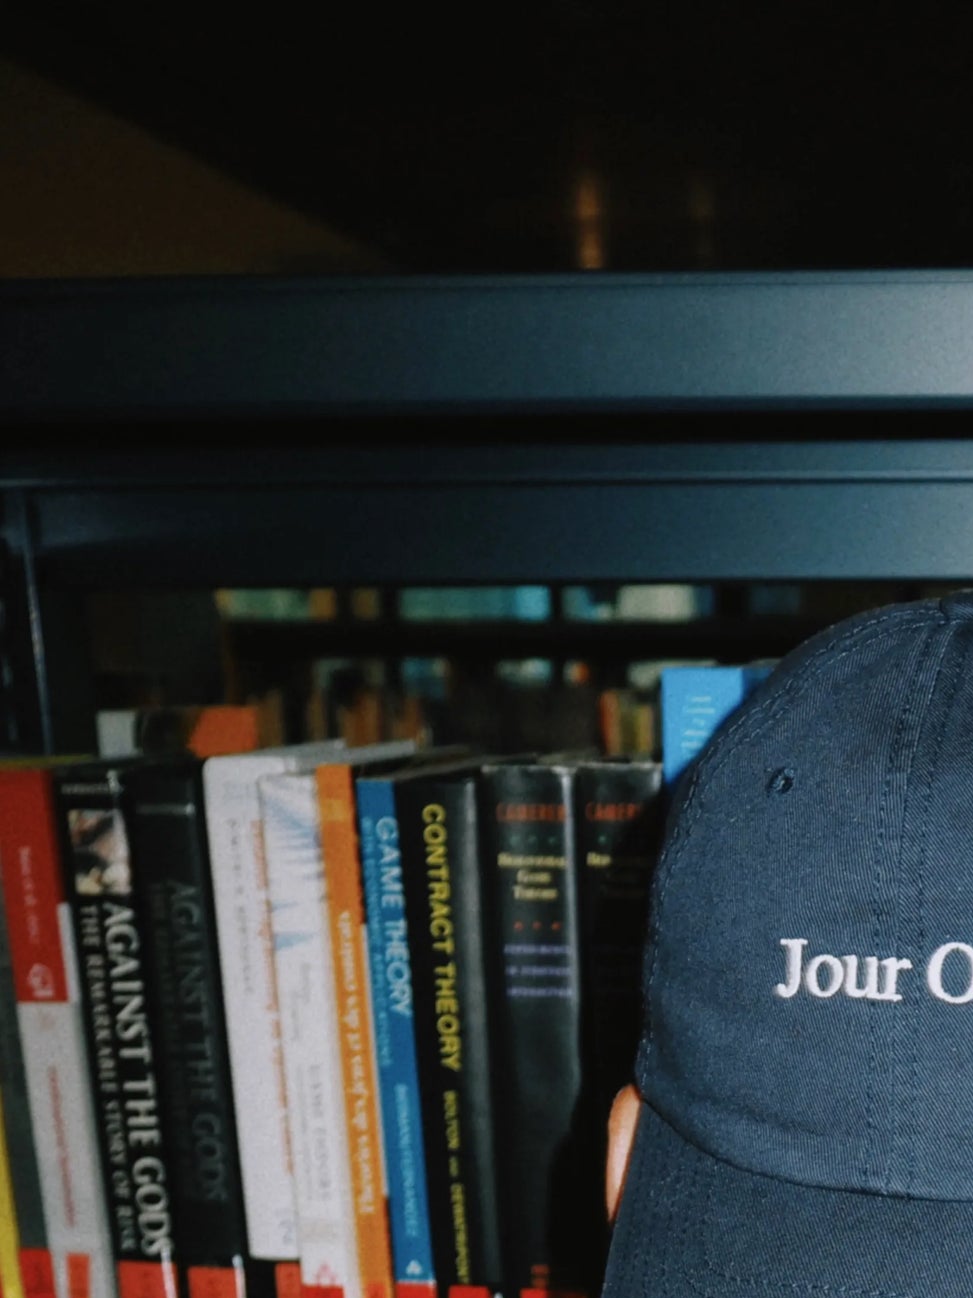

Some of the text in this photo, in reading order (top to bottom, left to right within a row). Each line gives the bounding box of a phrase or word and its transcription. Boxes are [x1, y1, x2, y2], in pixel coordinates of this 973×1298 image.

[167, 879, 209, 1027] AGAINST
[375, 815, 413, 1019] GAME THEORY
[421, 803, 462, 1073] CONTRACT THEORY
[772, 938, 912, 1001] Jour
[103, 902, 153, 1065] AGAINST
[80, 904, 136, 1251] THE REMARKABLE STORY OF RISK
[122, 1072, 162, 1149] THE
[185, 1034, 217, 1102] THE
[131, 1156, 177, 1258] GODS
[192, 1112, 229, 1202] GODS
